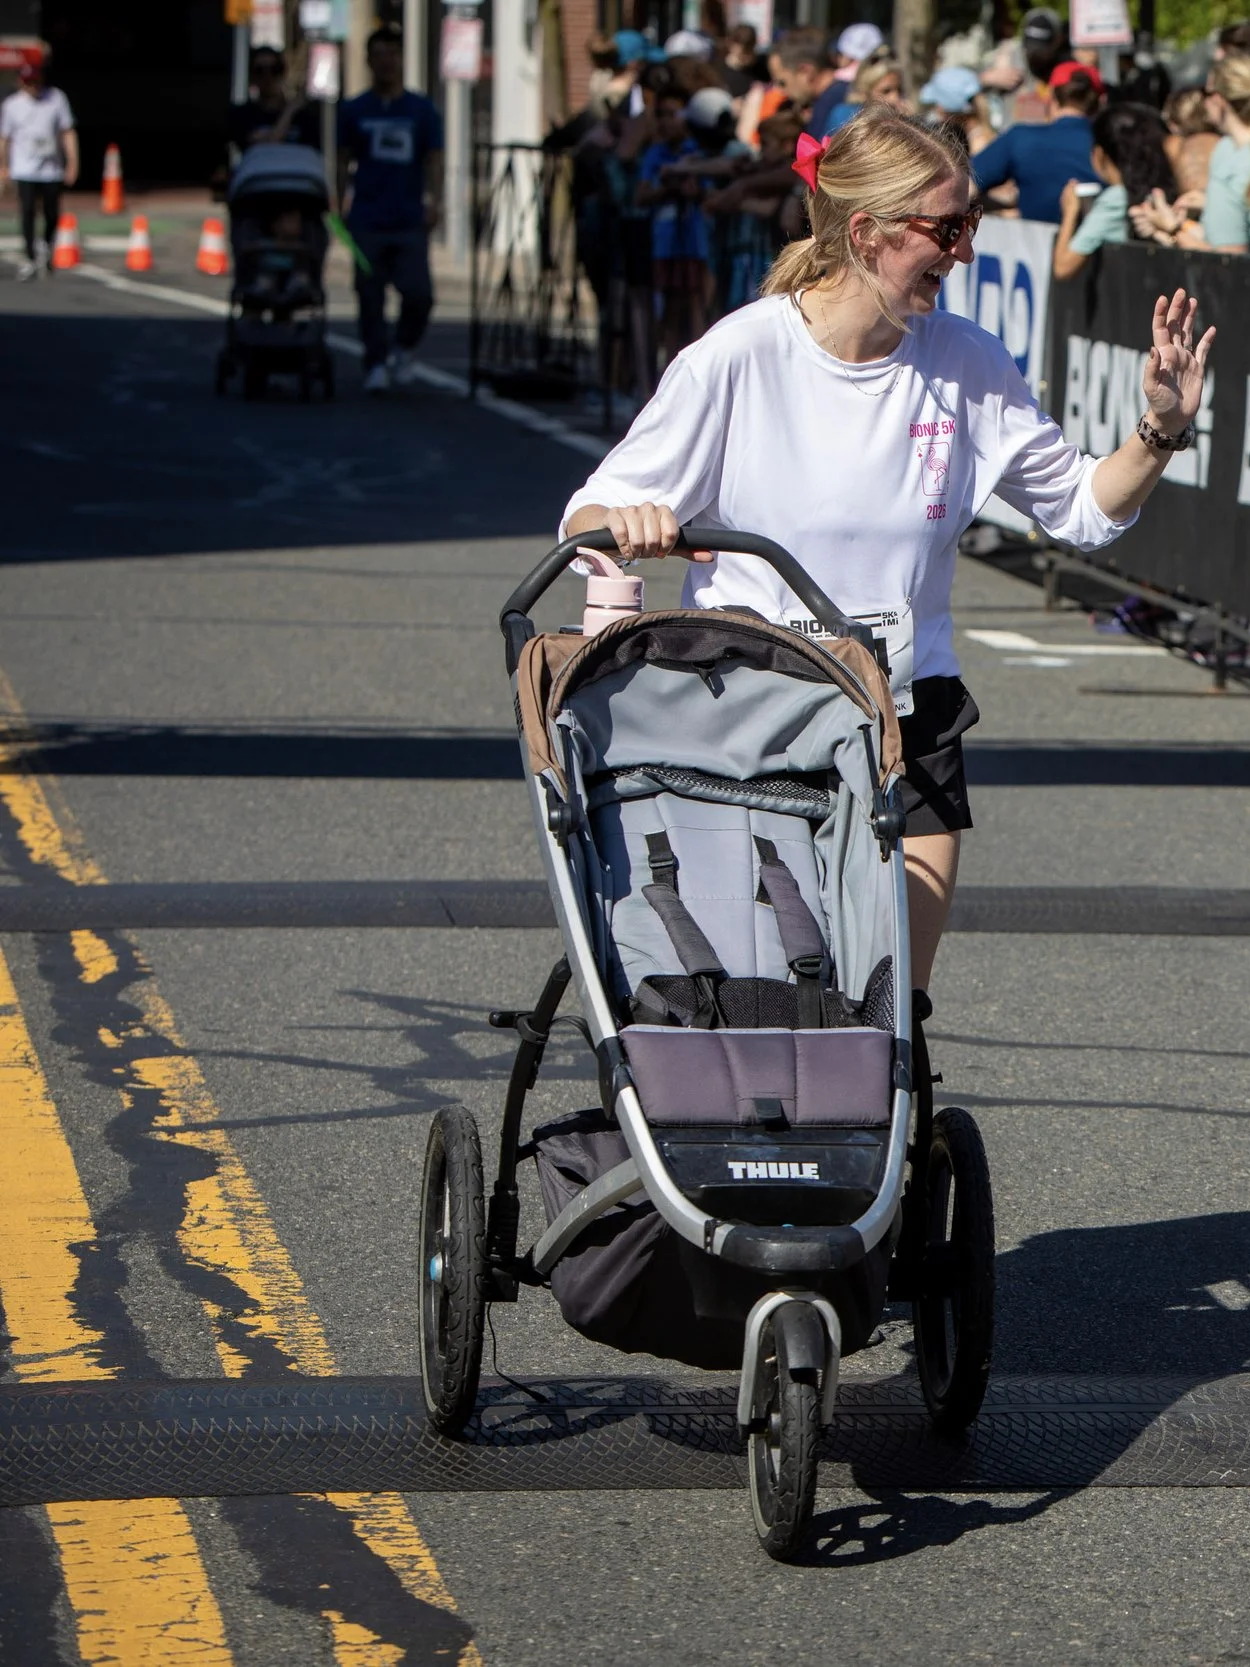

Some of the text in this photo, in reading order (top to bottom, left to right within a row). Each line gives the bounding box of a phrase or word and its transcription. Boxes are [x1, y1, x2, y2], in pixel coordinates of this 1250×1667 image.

[909, 420, 956, 438] BIONIC 5K
[926, 504, 946, 520] 2026
[728, 1161, 820, 1180] THULE
